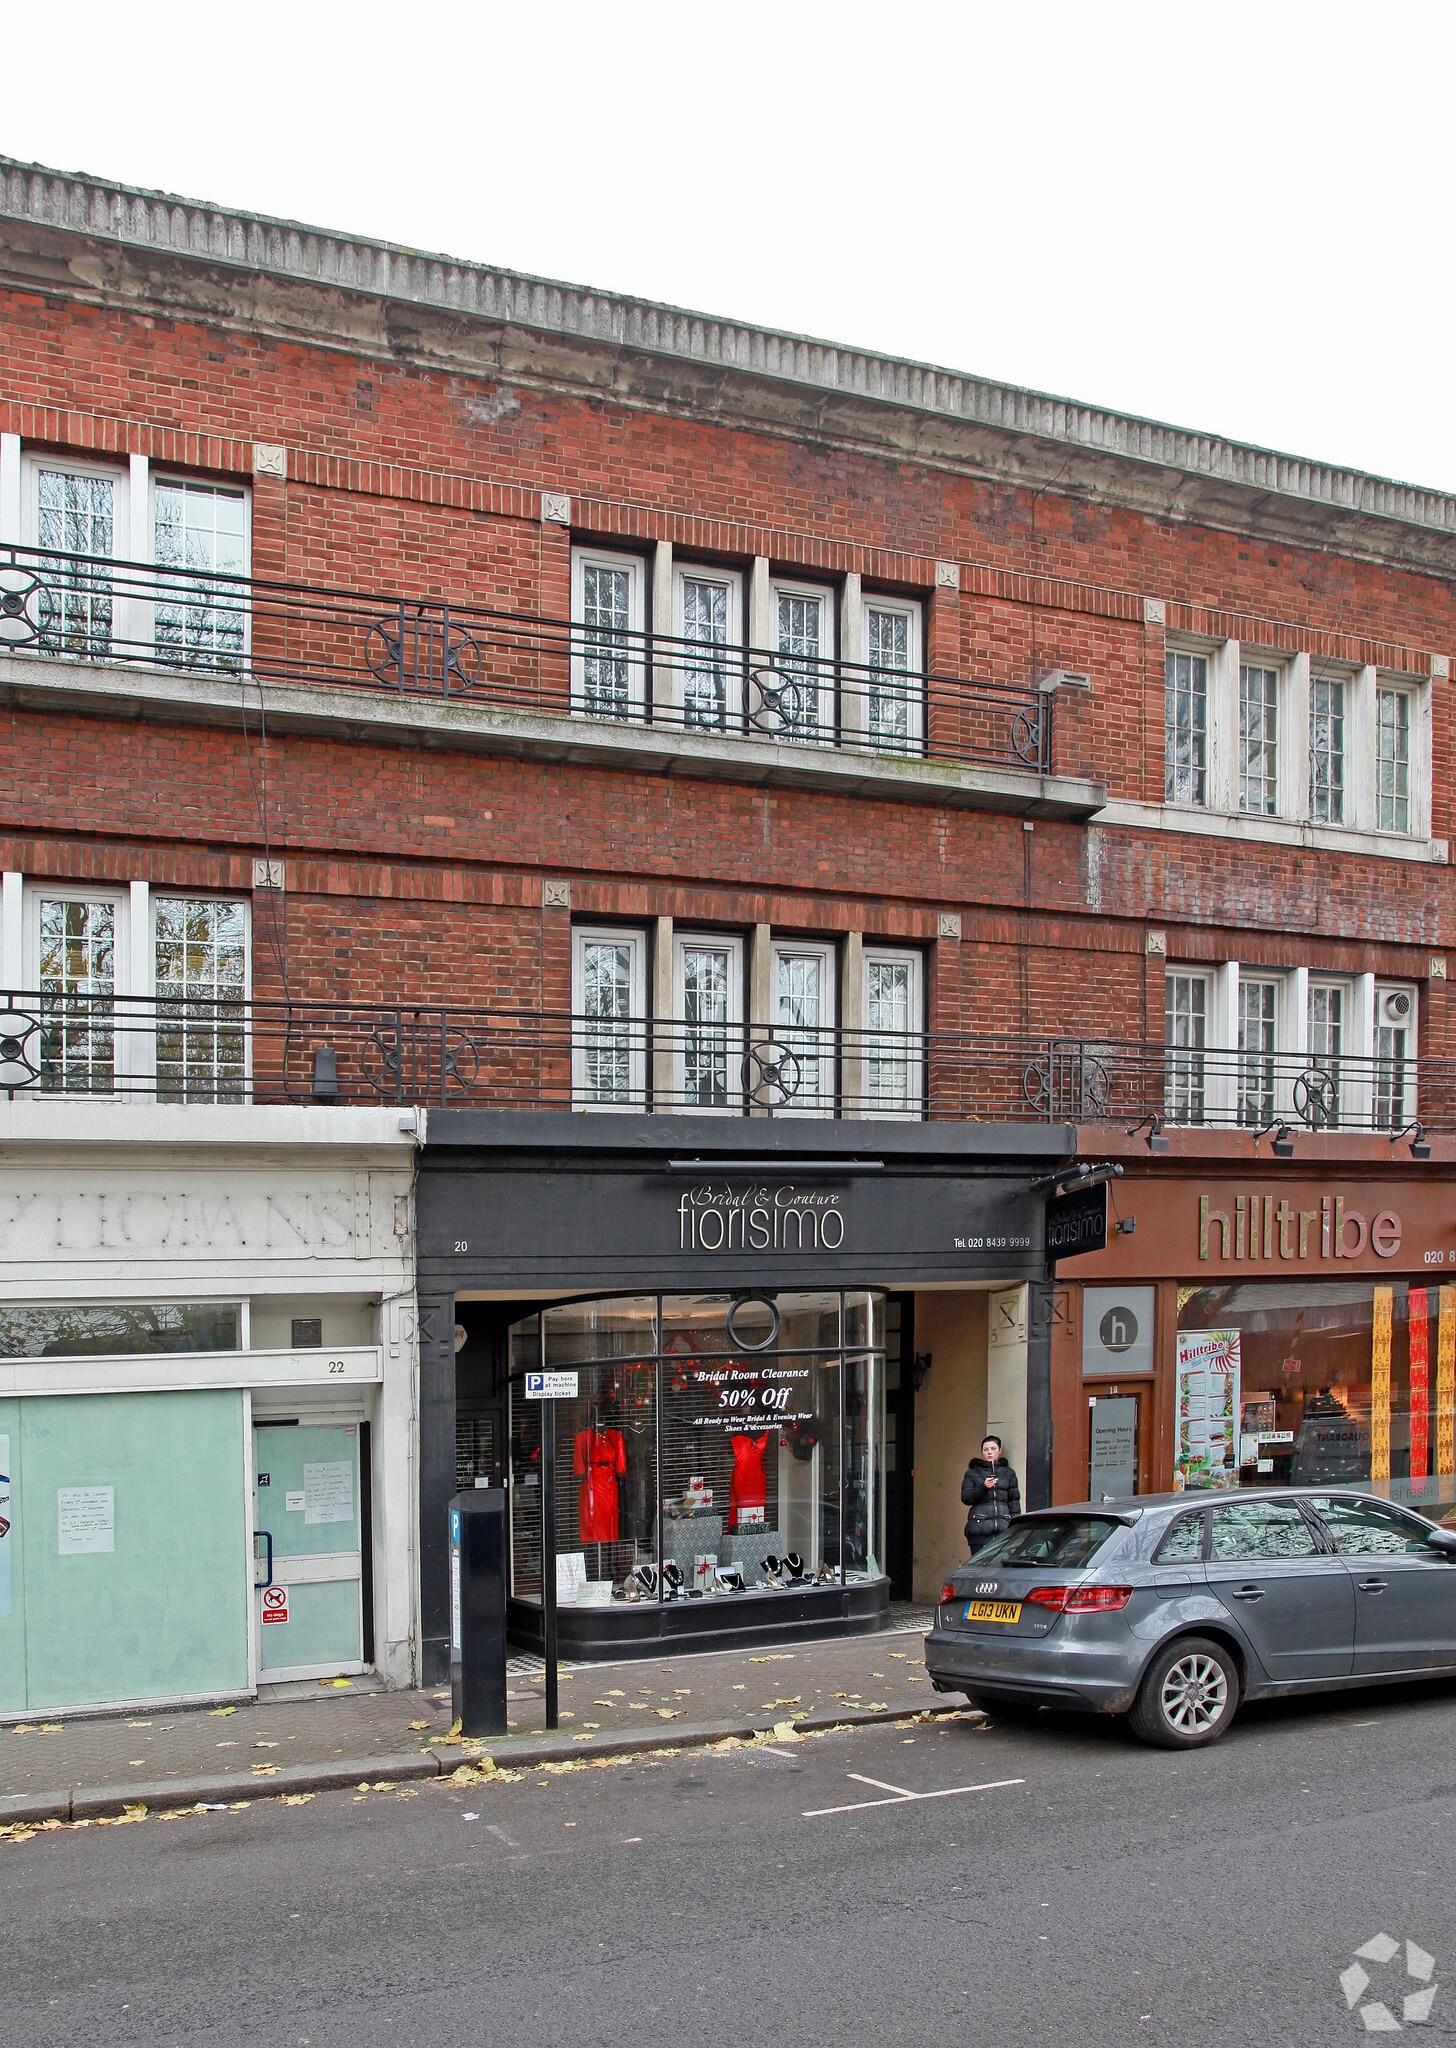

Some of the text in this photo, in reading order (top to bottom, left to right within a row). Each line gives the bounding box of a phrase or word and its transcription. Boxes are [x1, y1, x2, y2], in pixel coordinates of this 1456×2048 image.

[690, 1181, 840, 1208] Bridal & Couture
[1200, 1195, 1402, 1260] hilltribe
[454, 1241, 468, 1252] 20
[968, 1238, 983, 1248] 020
[986, 1237, 1006, 1248] 8439
[1009, 1237, 1030, 1248] 9999
[1424, 1250, 1444, 1264] 020
[1111, 1315, 1126, 1344] h
[1179, 1341, 1224, 1364] Hilltribe
[328, 1361, 345, 1373] 22
[697, 1368, 809, 1382] Bridal Room Clearance
[718, 1387, 793, 1409] 50% Off
[704, 1417, 722, 1425] Ready
[746, 1414, 766, 1422] Bridal
[773, 1413, 797, 1422] Evening
[797, 1412, 813, 1420] Wear
[971, 1602, 1017, 1619] LG13 UKN
